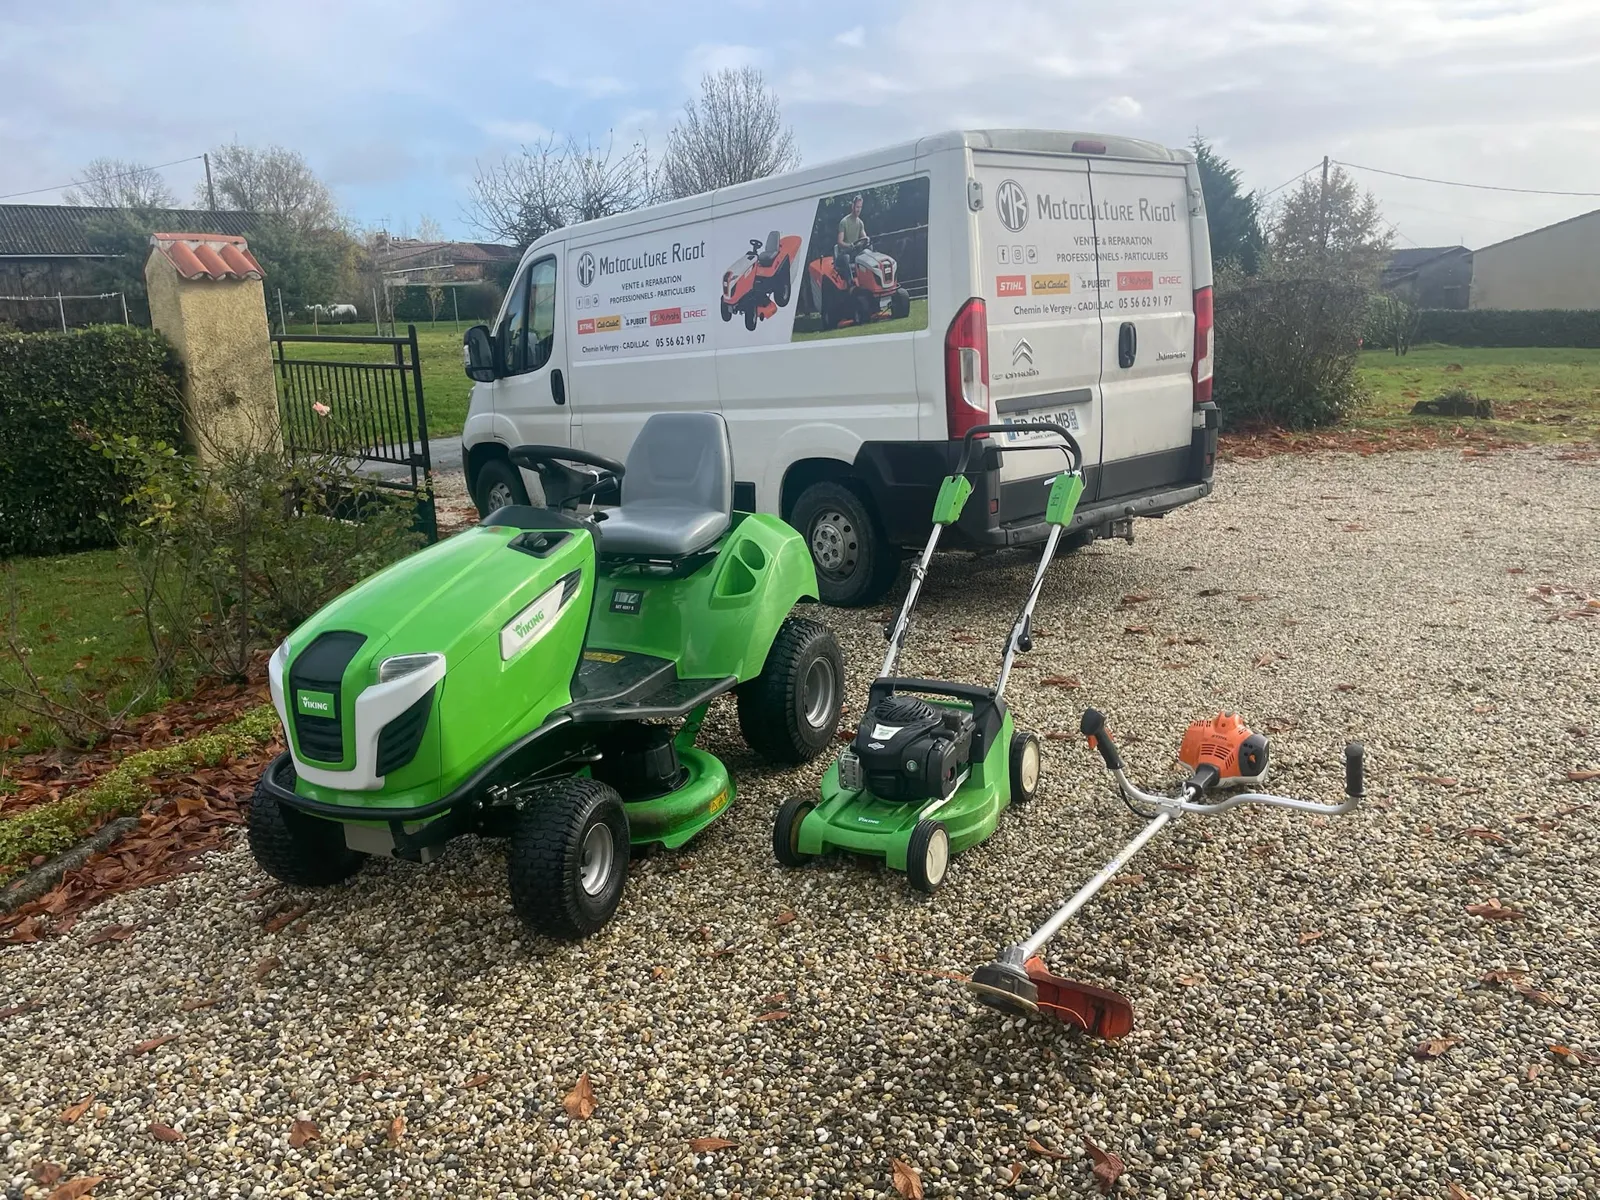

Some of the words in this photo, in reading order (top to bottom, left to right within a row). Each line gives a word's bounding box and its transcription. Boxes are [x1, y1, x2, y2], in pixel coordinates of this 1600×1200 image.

[1073, 236, 1100, 246] VENTE
[1107, 236, 1152, 246] REPARATION
[1056, 252, 1120, 262] PROFESSIONNELS
[1124, 252, 1168, 262] PARTICULIERS
[621, 281, 640, 291] VENTE
[645, 275, 682, 287] REPARATION
[1034, 281, 1047, 289] Cub
[1087, 279, 1111, 288] PUBERT
[1158, 276, 1182, 285] OREC
[1000, 281, 1023, 291] STIHL
[609, 292, 653, 304] PROFESSIONNELS
[657, 285, 696, 298] PARTICULIERS
[1013, 305, 1041, 315] Chemin
[1042, 304, 1049, 314] le
[1049, 303, 1072, 315] Vergey
[1077, 300, 1114, 311] CADILLAC
[1118, 298, 1128, 309] 05
[1130, 297, 1140, 308] 56
[1141, 296, 1151, 307] 62
[1152, 296, 1161, 306] 91
[1163, 295, 1173, 306] 97
[683, 309, 706, 319] OREC
[630, 317, 647, 326] PUBERT
[622, 339, 649, 350] CADILLAC
[655, 338, 664, 348] 05
[665, 336, 675, 347] 56
[675, 335, 684, 346] 62
[685, 334, 694, 345] 91
[696, 333, 705, 344] 97
[516, 610, 545, 638] VIKING
[302, 699, 328, 711] VIKING
